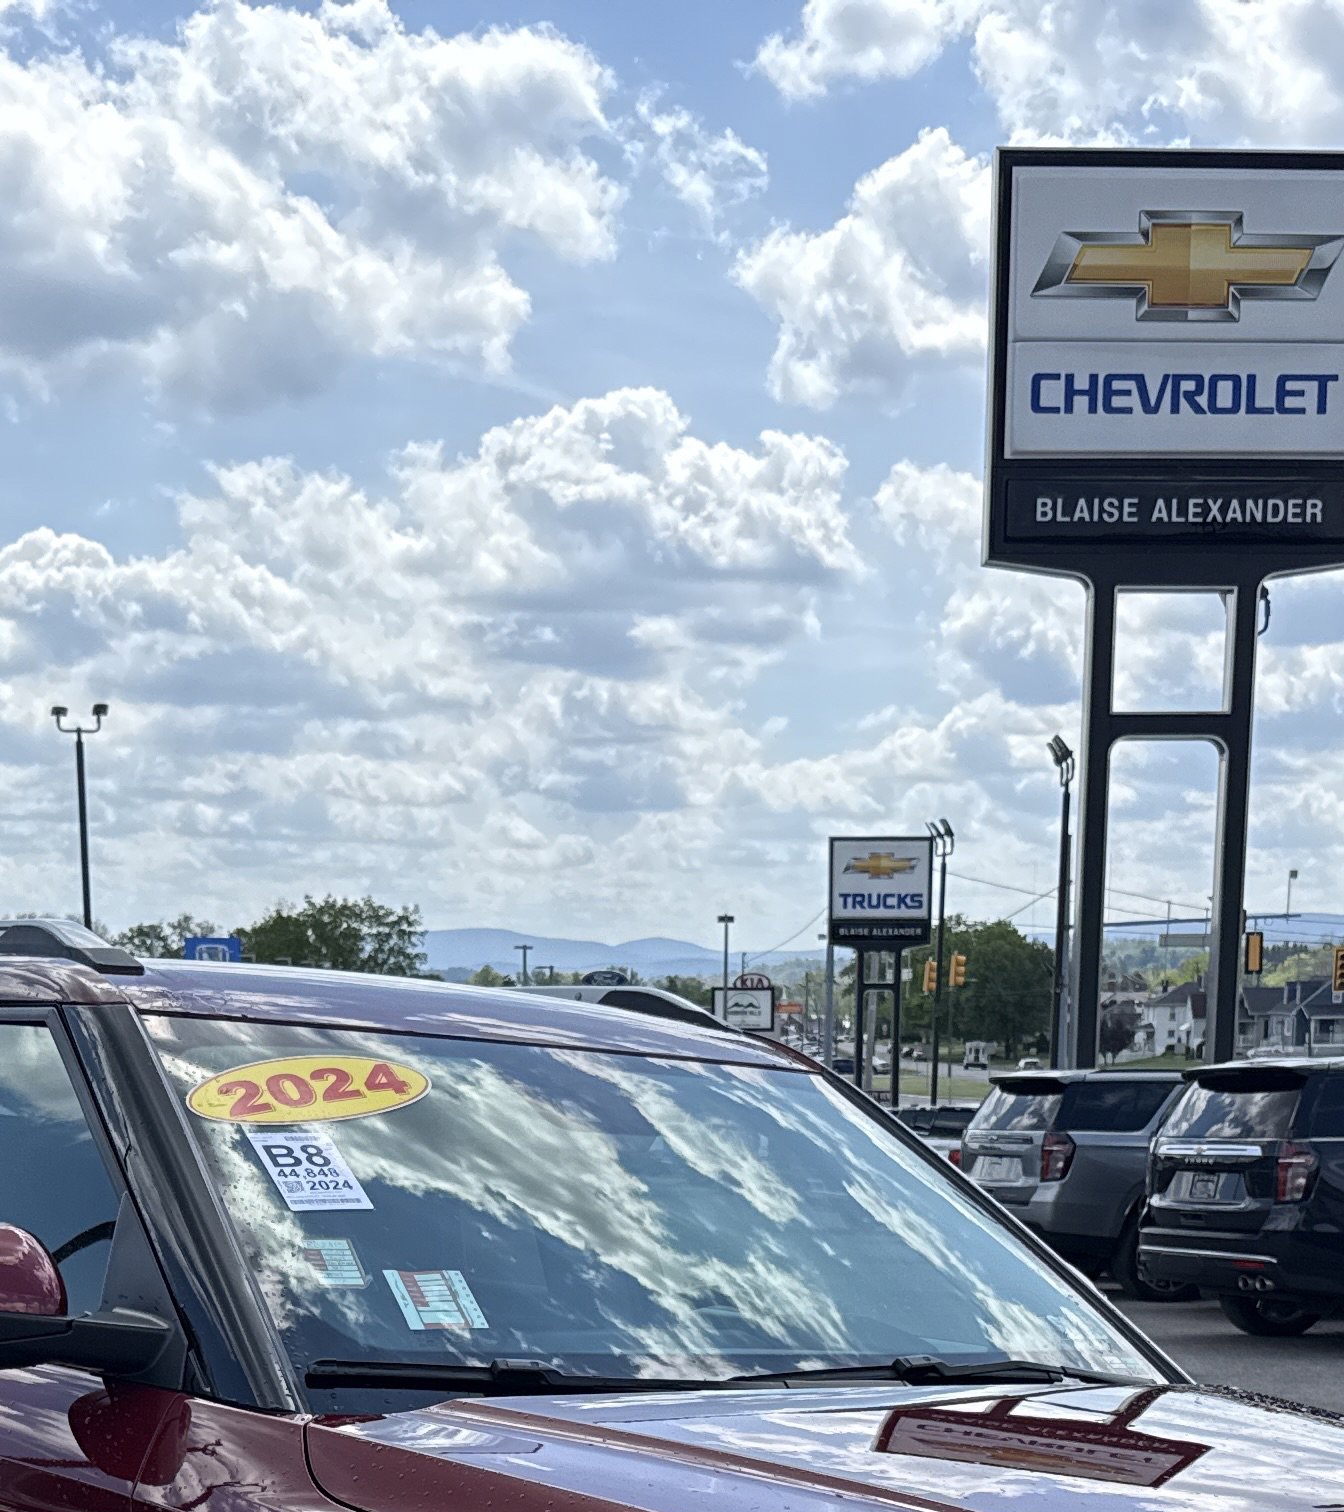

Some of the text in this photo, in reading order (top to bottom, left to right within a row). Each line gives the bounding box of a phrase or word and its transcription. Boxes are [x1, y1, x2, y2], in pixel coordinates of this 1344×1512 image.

[1030, 373, 1339, 415] CHEVROLET
[1035, 498, 1323, 523] BLAISE ALEXANDER
[838, 893, 923, 910] TRUCKS
[839, 927, 922, 936] BLAISE ALEXANDER
[740, 977, 764, 988] KIA
[217, 1063, 412, 1118] 2024
[262, 1144, 331, 1168] B8
[306, 1180, 354, 1191] 2024
